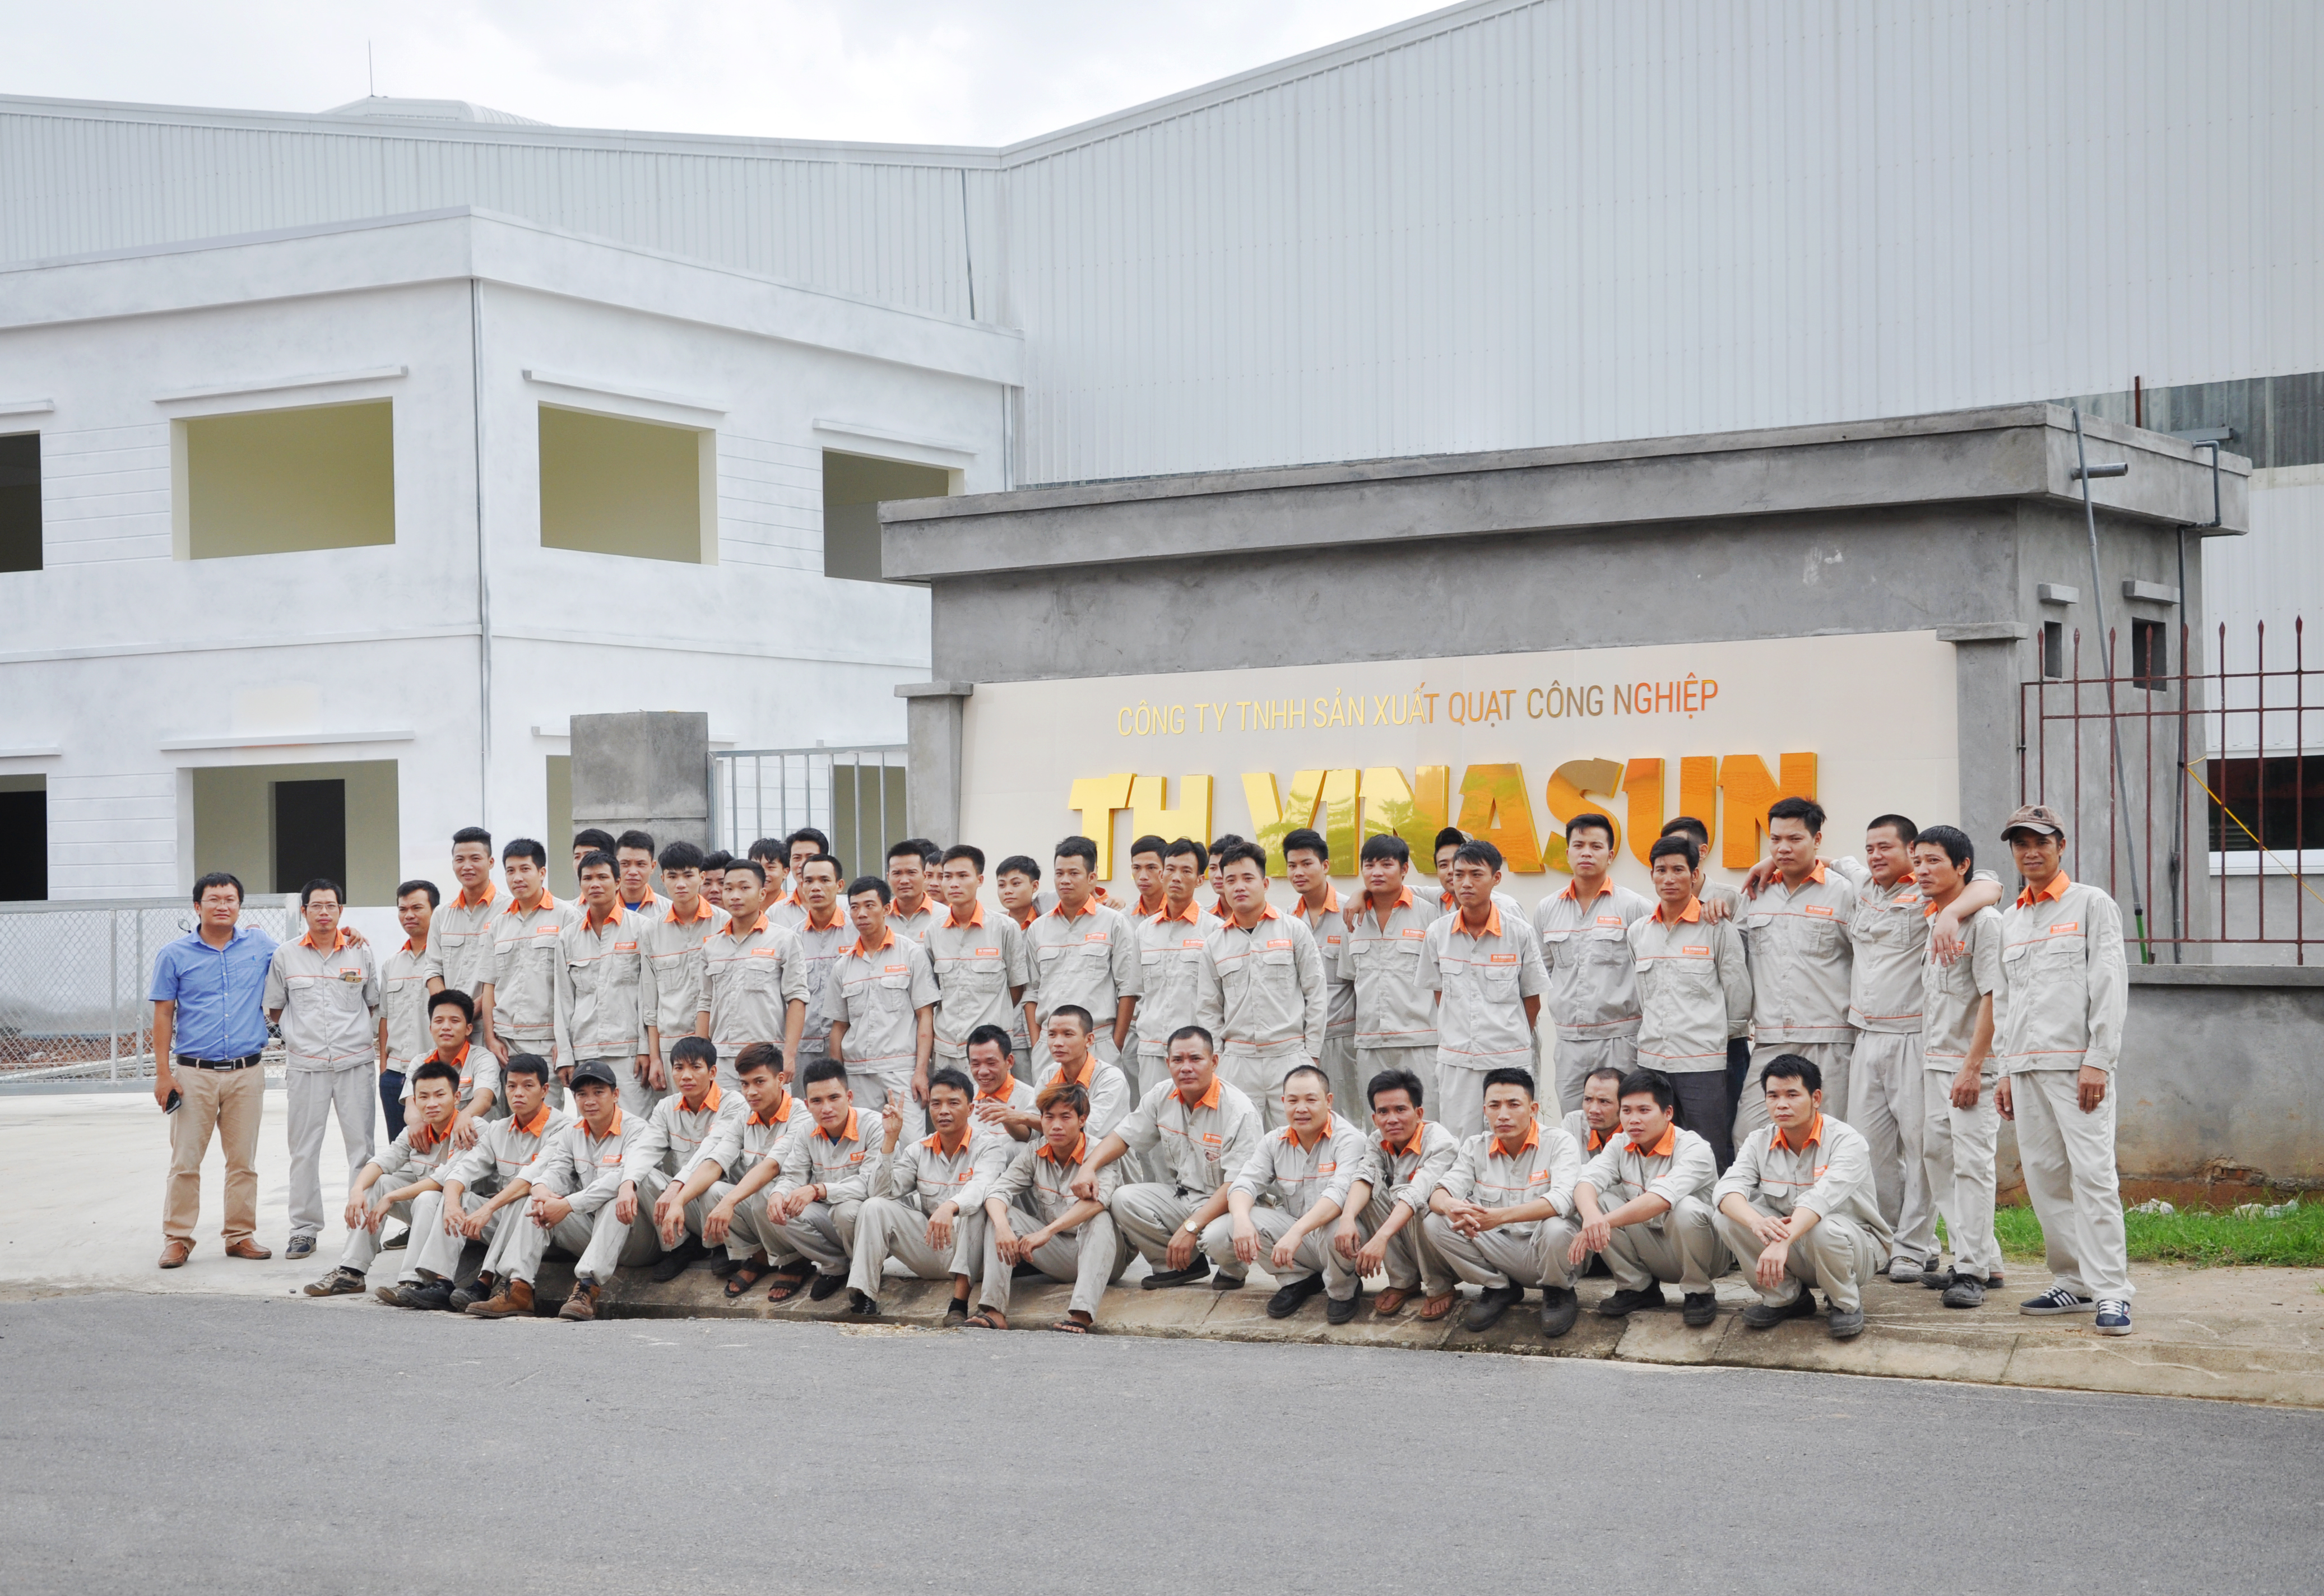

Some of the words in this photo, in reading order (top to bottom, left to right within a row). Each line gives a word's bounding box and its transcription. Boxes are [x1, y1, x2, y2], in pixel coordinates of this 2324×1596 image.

[1117, 699, 1185, 736] CÔNG
[1194, 702, 1228, 732] TY
[1236, 698, 1306, 731] TNHH
[1312, 687, 1365, 728] SẢN
[1373, 682, 1440, 726] XUẤT
[1448, 689, 1517, 728] QUẠT
[1527, 680, 1603, 720] CÔNG
[1613, 672, 1718, 720] NGHIỆP
[1068, 772, 1213, 880] TH
[1241, 751, 1817, 878] VINASUN
